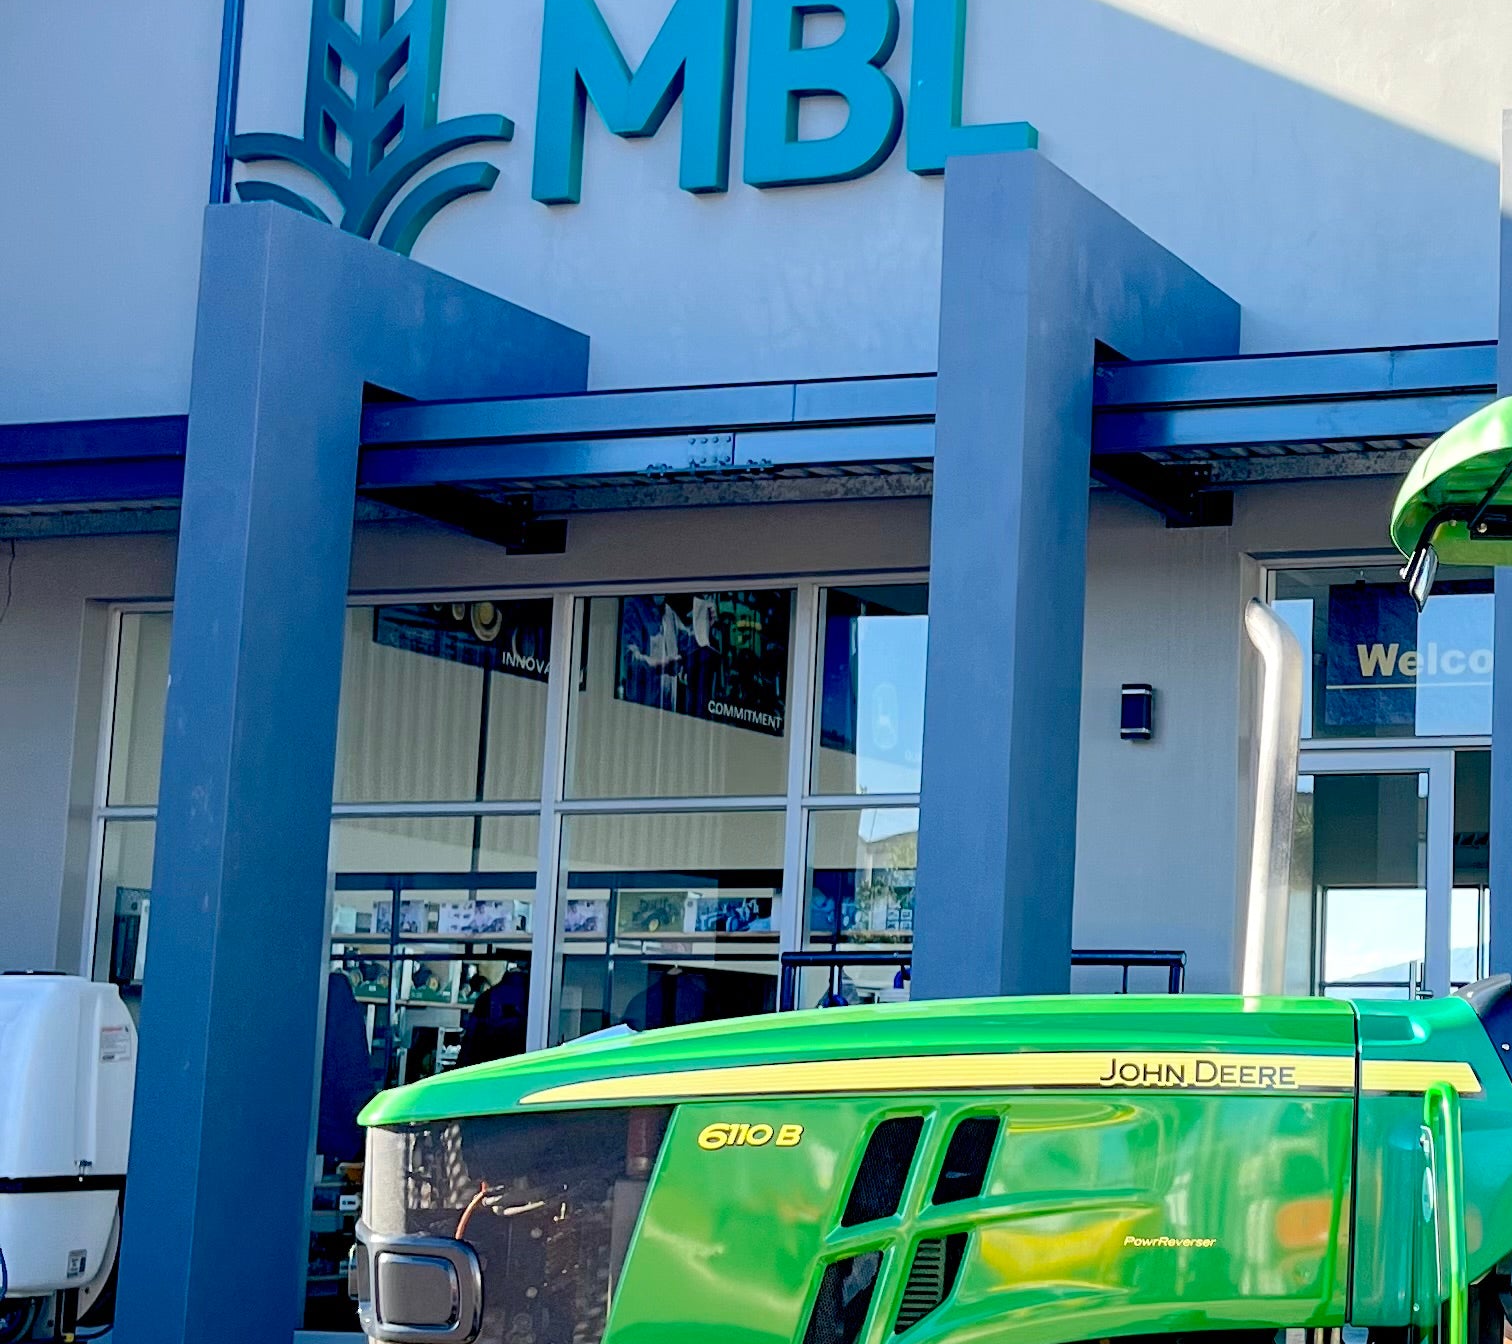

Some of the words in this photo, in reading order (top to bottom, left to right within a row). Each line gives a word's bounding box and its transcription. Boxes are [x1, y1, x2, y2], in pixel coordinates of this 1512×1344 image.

[1356, 642, 1494, 677] Welco
[708, 699, 783, 730] COMMITMENT
[1099, 1057, 1186, 1082] JOHN
[1195, 1059, 1297, 1086] DEERE
[698, 1122, 775, 1150] 6110
[775, 1123, 805, 1147] B
[1123, 1235, 1217, 1248] PowrReverser
